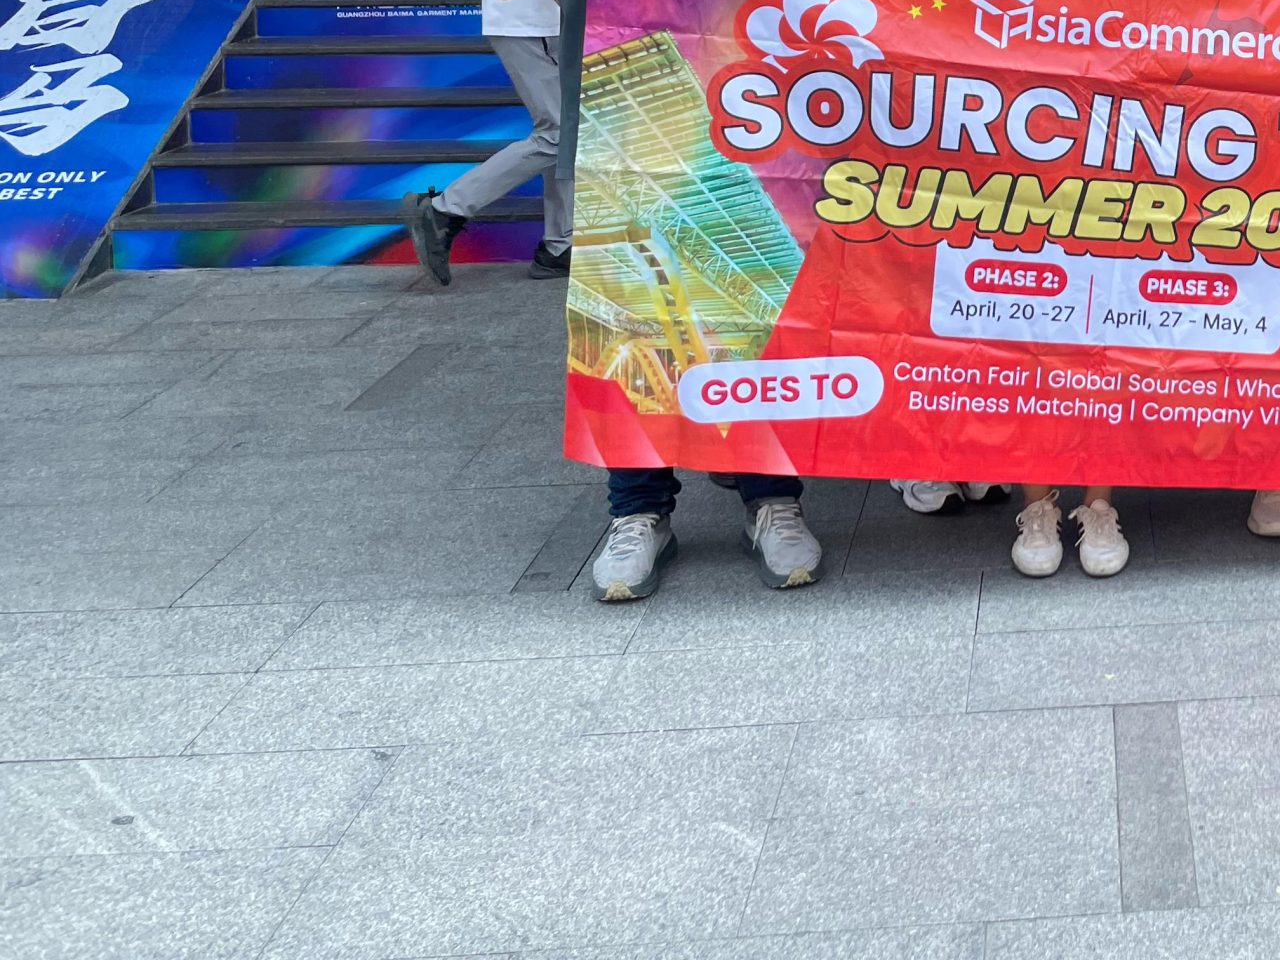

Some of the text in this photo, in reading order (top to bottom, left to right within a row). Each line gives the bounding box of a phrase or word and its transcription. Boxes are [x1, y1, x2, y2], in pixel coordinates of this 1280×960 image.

[719, 69, 1258, 184] SOURCING
[37, 170, 107, 184] ONLY
[0, 187, 64, 200] BEST
[815, 157, 1188, 248] SUMMER
[972, 267, 1059, 289] PHASE 2:
[1146, 277, 1230, 297] PHASE 3:
[950, 298, 1002, 323] April,
[1008, 301, 1035, 321] 20
[1102, 308, 1154, 330] April,
[1159, 311, 1183, 329] 27
[1203, 313, 1248, 336] May,
[1255, 316, 1268, 332] 4
[700, 373, 859, 406] GOES TO
[893, 362, 981, 385] Canton
[987, 365, 1029, 386] Fair
[1048, 370, 1122, 392] Global
[1128, 373, 1217, 396] Sources
[908, 391, 1009, 413] Business
[1015, 395, 1123, 423] Matching
[1141, 401, 1254, 428] Company
